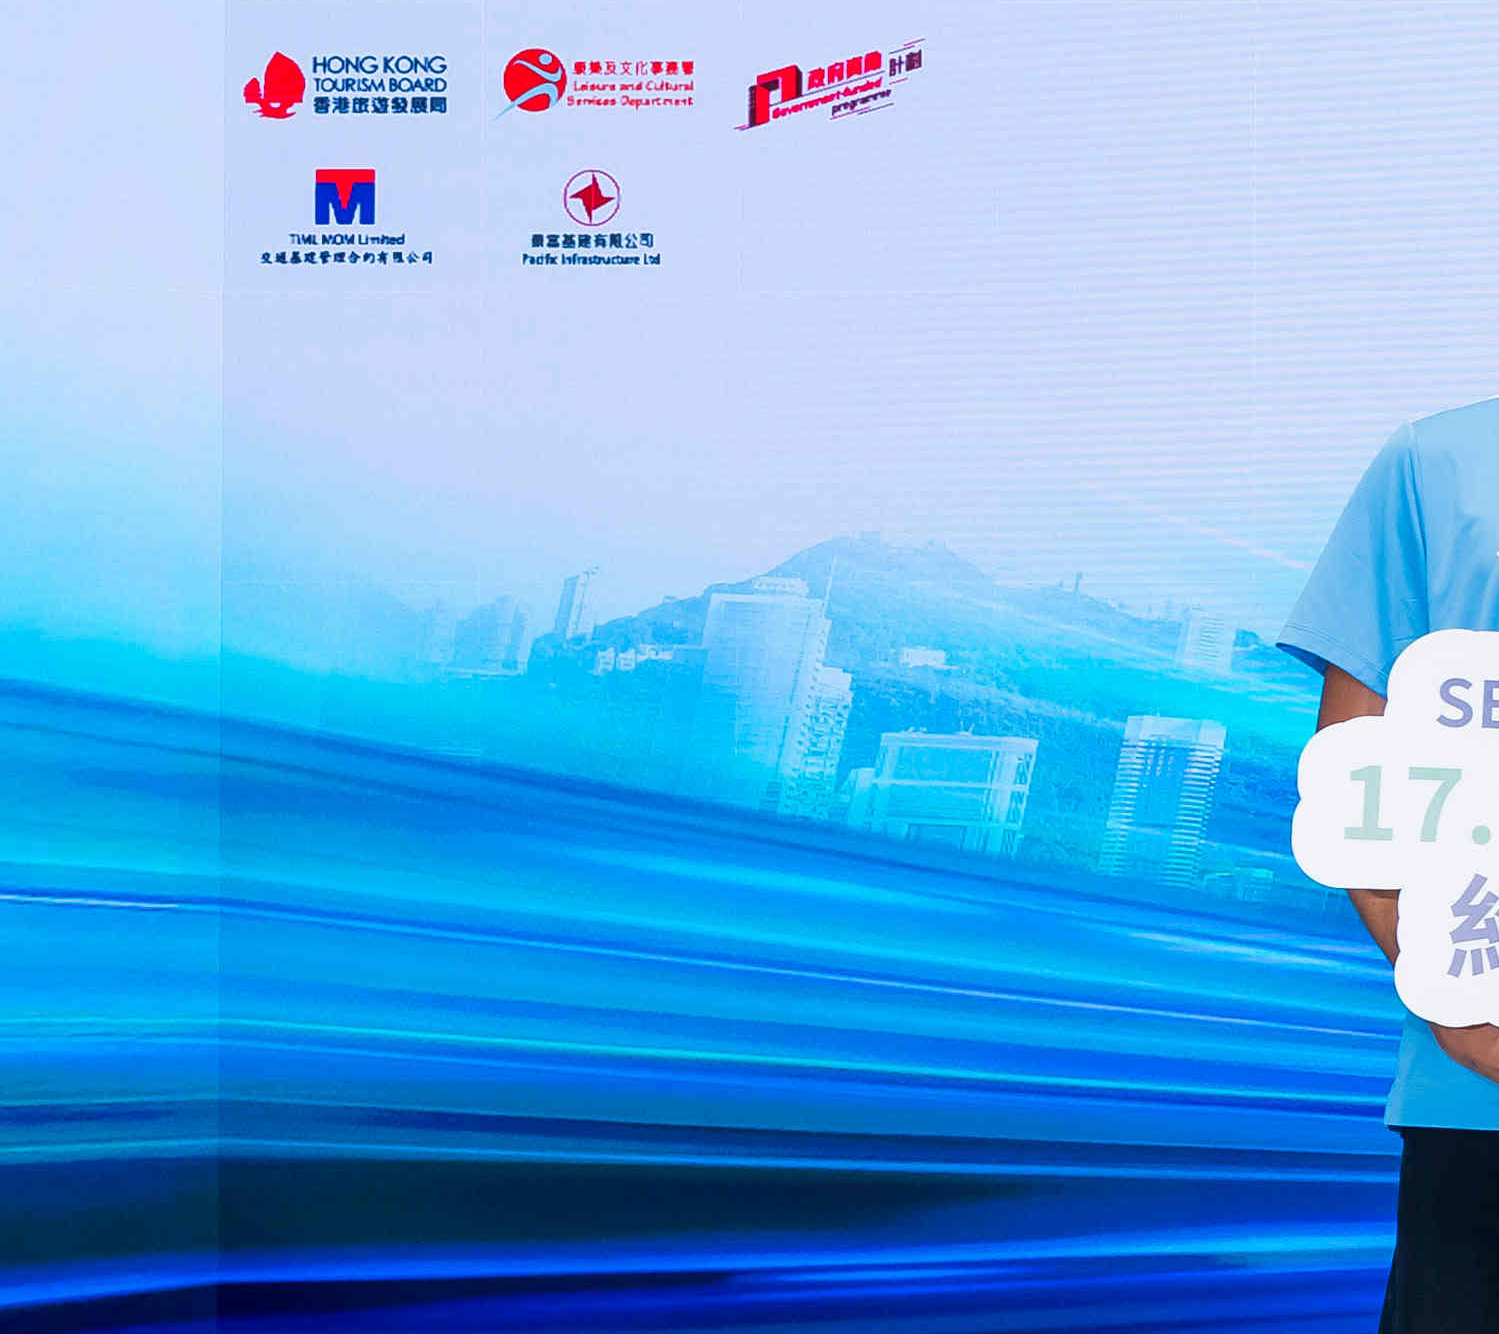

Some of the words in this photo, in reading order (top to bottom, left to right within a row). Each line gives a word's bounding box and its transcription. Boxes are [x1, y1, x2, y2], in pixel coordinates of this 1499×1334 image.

[312, 55, 379, 75] HONG
[382, 55, 448, 75] KONG
[313, 77, 386, 93] TOURISM
[388, 77, 448, 93] BOARD
